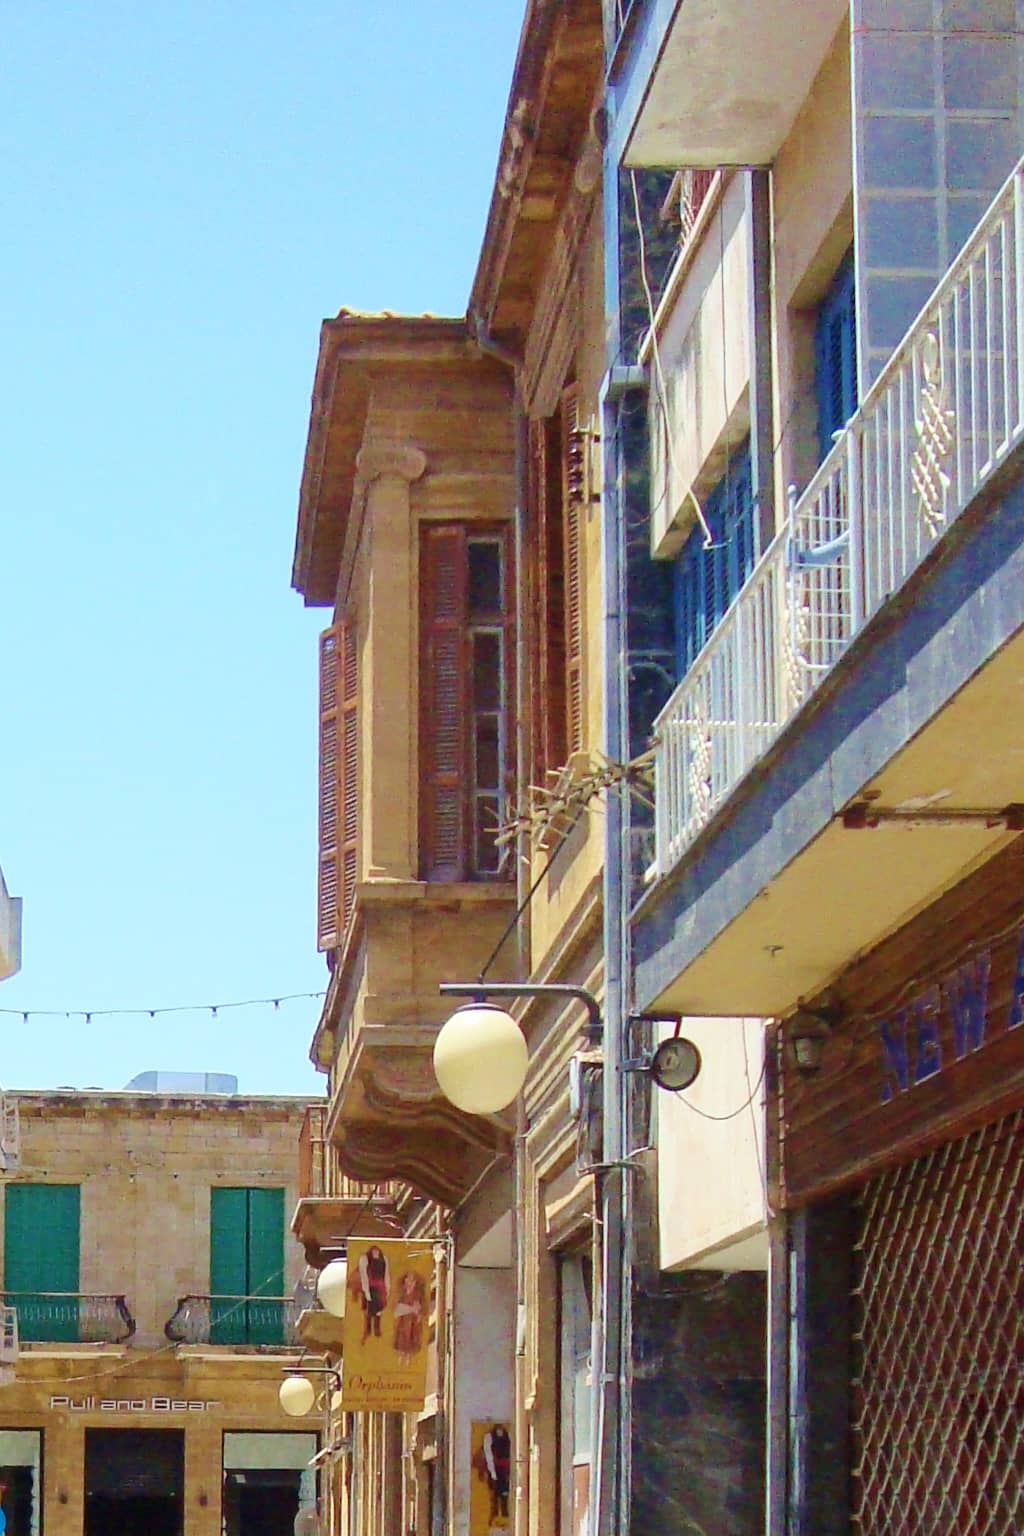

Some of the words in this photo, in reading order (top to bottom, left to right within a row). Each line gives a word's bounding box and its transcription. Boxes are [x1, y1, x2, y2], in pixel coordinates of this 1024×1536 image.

[879, 948, 991, 1107] NEW
[50, 1396, 95, 1410] Pull
[100, 1399, 146, 1411] and
[151, 1397, 222, 1411] Bear
